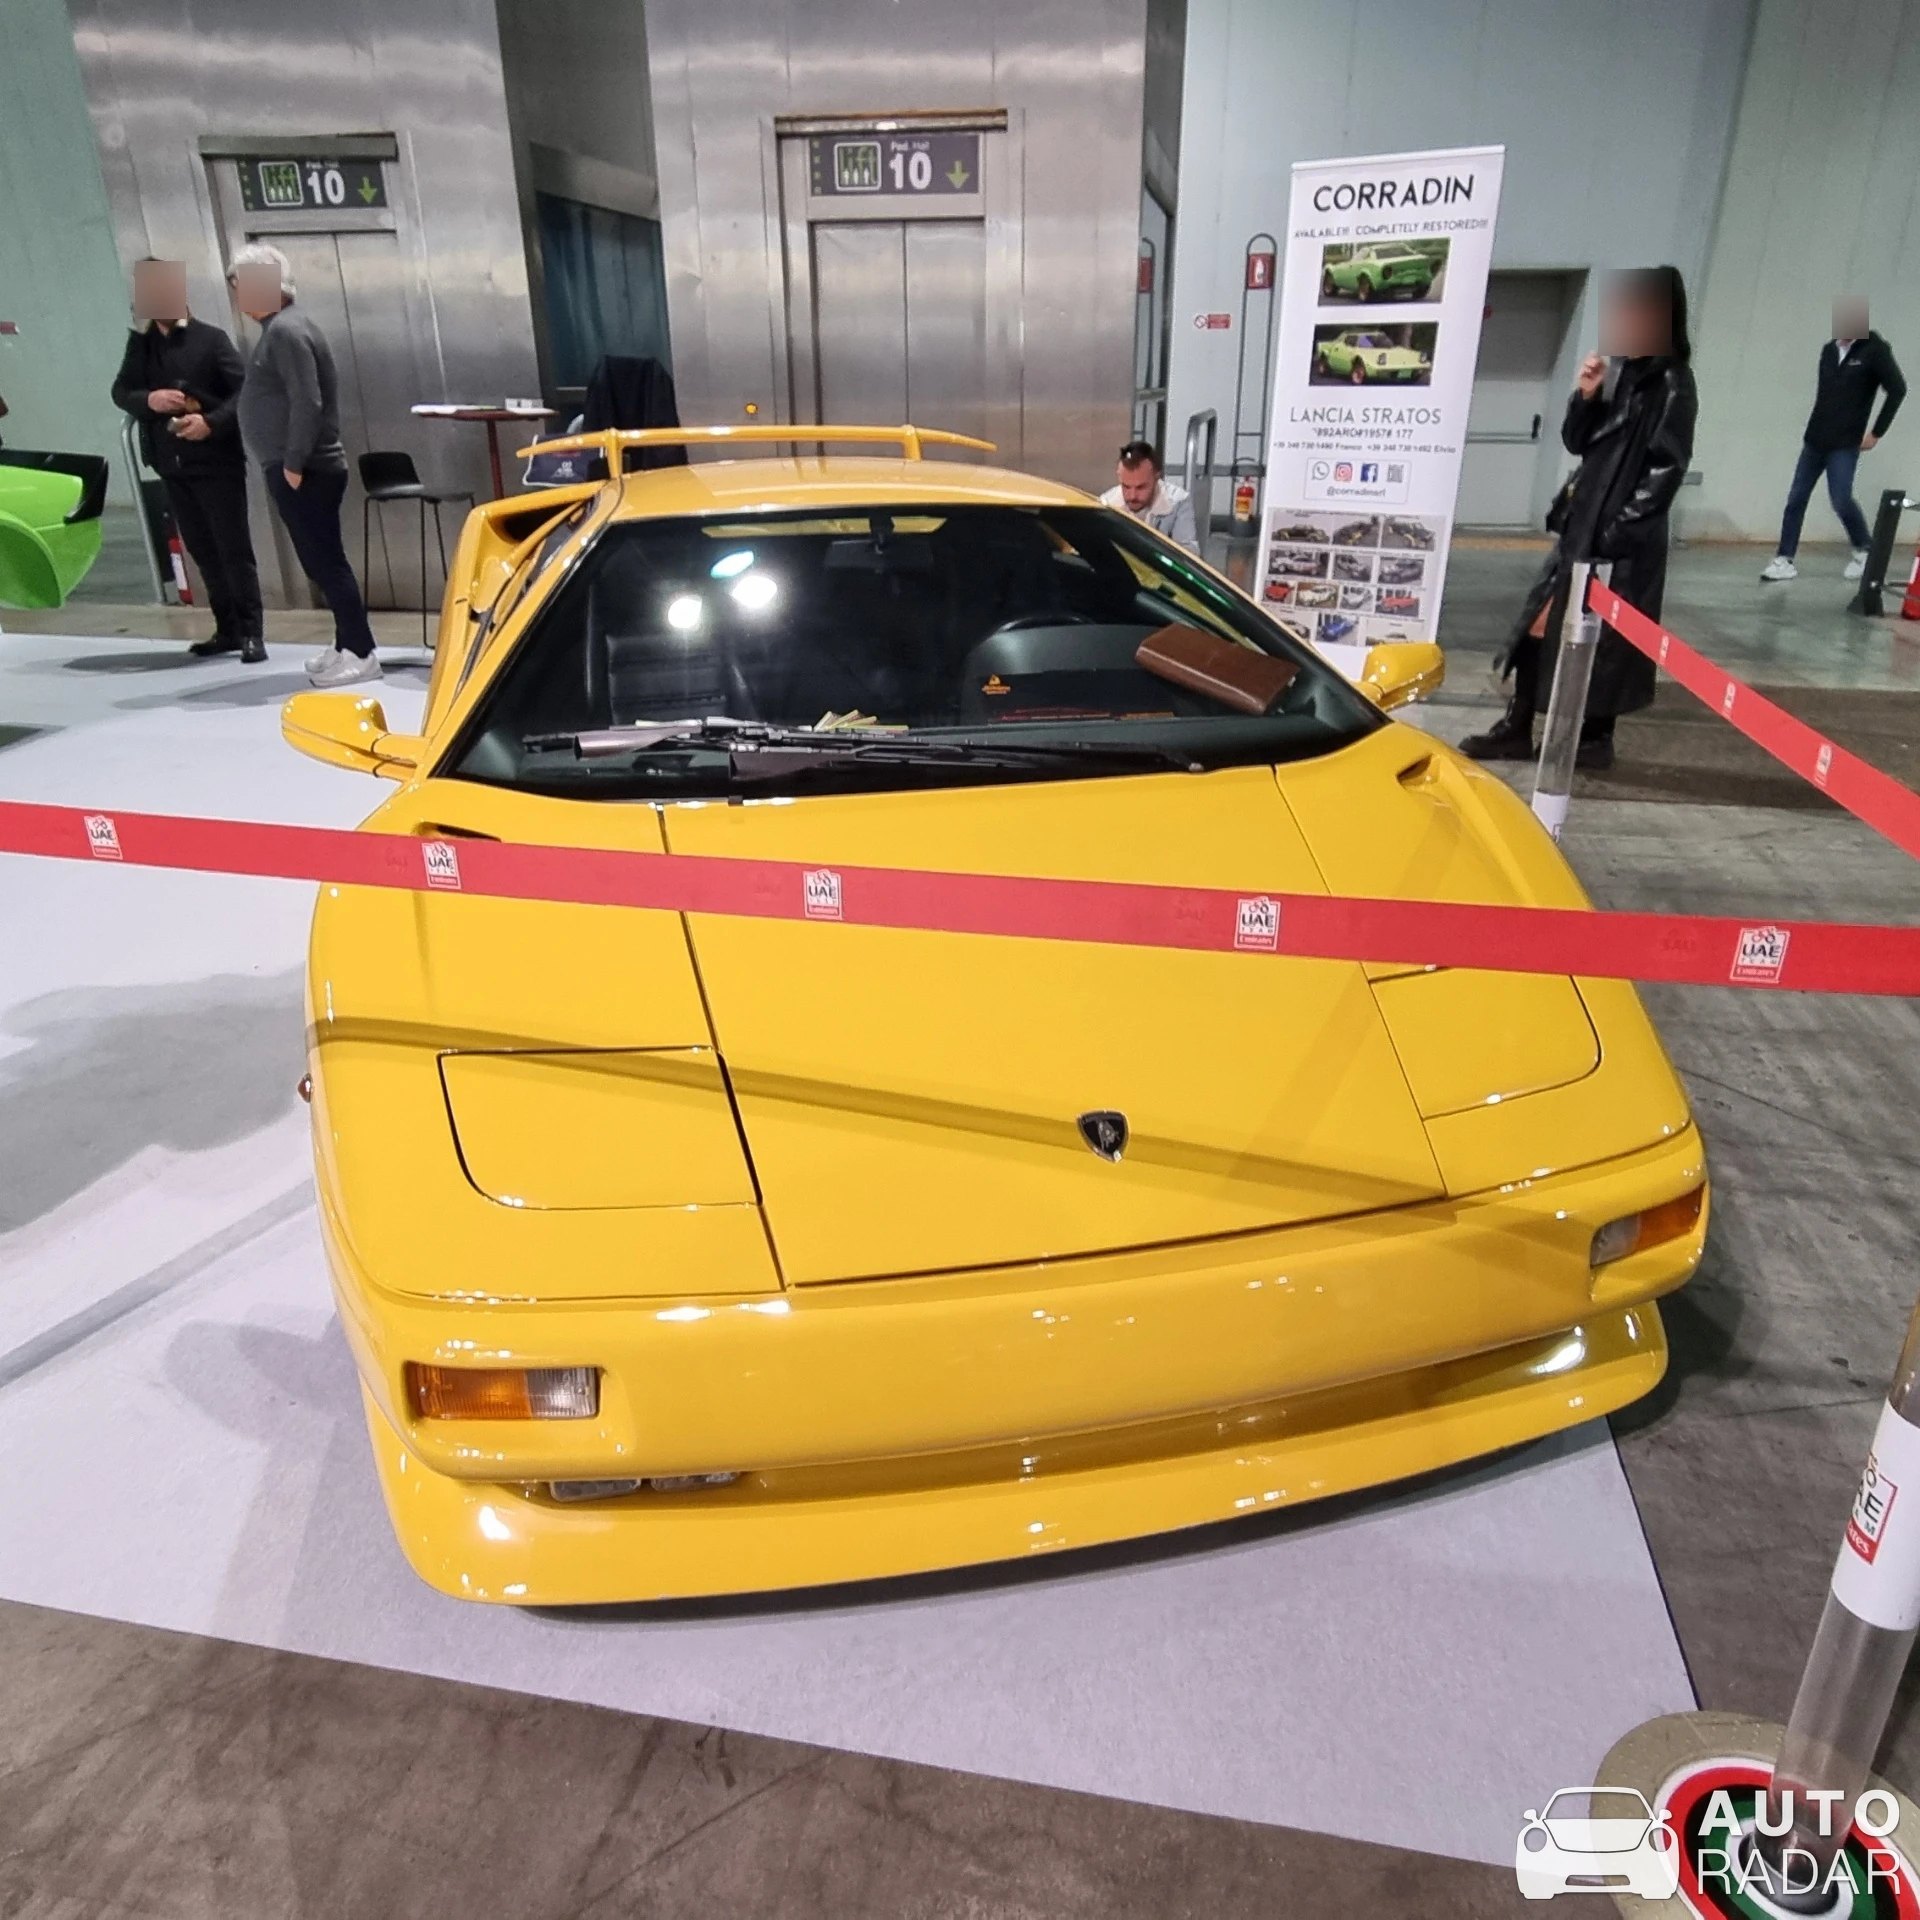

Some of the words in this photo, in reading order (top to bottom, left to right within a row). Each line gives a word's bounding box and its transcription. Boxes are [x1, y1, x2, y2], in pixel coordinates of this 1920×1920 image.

[889, 151, 932, 190] 10
[308, 169, 345, 204] 10
[1313, 174, 1475, 212] CORRADIN
[1355, 221, 1420, 236] COMPLETELY
[1290, 407, 1354, 423] LANCIA
[1361, 407, 1442, 425] STRATOS
[1396, 429, 1414, 439] 177
[90, 829, 115, 841] UAE
[428, 857, 453, 869] UAE
[1241, 913, 1274, 928] UAE
[1742, 943, 1781, 958] UAE
